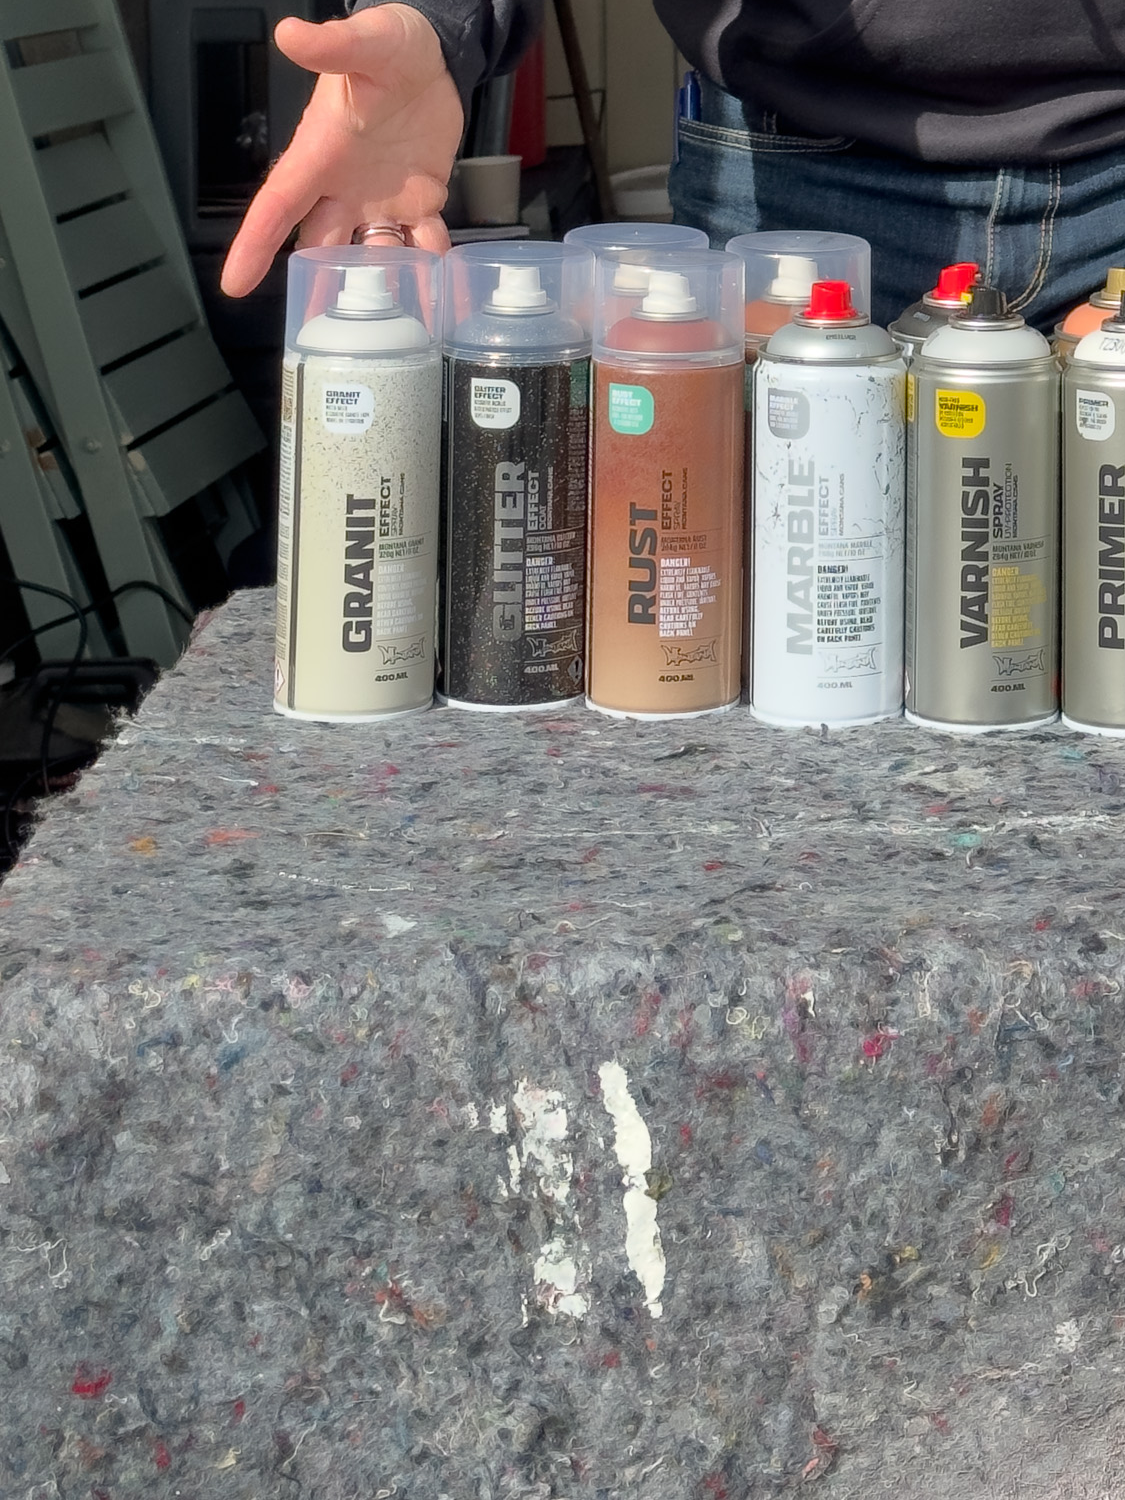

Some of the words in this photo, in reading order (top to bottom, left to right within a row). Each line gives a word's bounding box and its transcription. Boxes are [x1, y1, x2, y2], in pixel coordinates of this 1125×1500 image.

[379, 475, 392, 538] EFFECT
[527, 470, 540, 531] EFFECT
[539, 505, 547, 531] COAT
[662, 470, 673, 530] EFFECT
[818, 476, 830, 537] EFFECT
[993, 482, 1005, 539] SPRAY
[1005, 462, 1013, 539] UV-PROTECTION
[342, 493, 376, 653] GRANIT
[379, 540, 407, 551] MONTANA
[493, 461, 525, 640] GLITTER
[628, 501, 658, 625] RUST
[786, 458, 815, 656] MARBLE
[960, 457, 991, 650] VARNISH
[992, 543, 1022, 552] MONTANA
[1098, 463, 1125, 651] PRIMER
